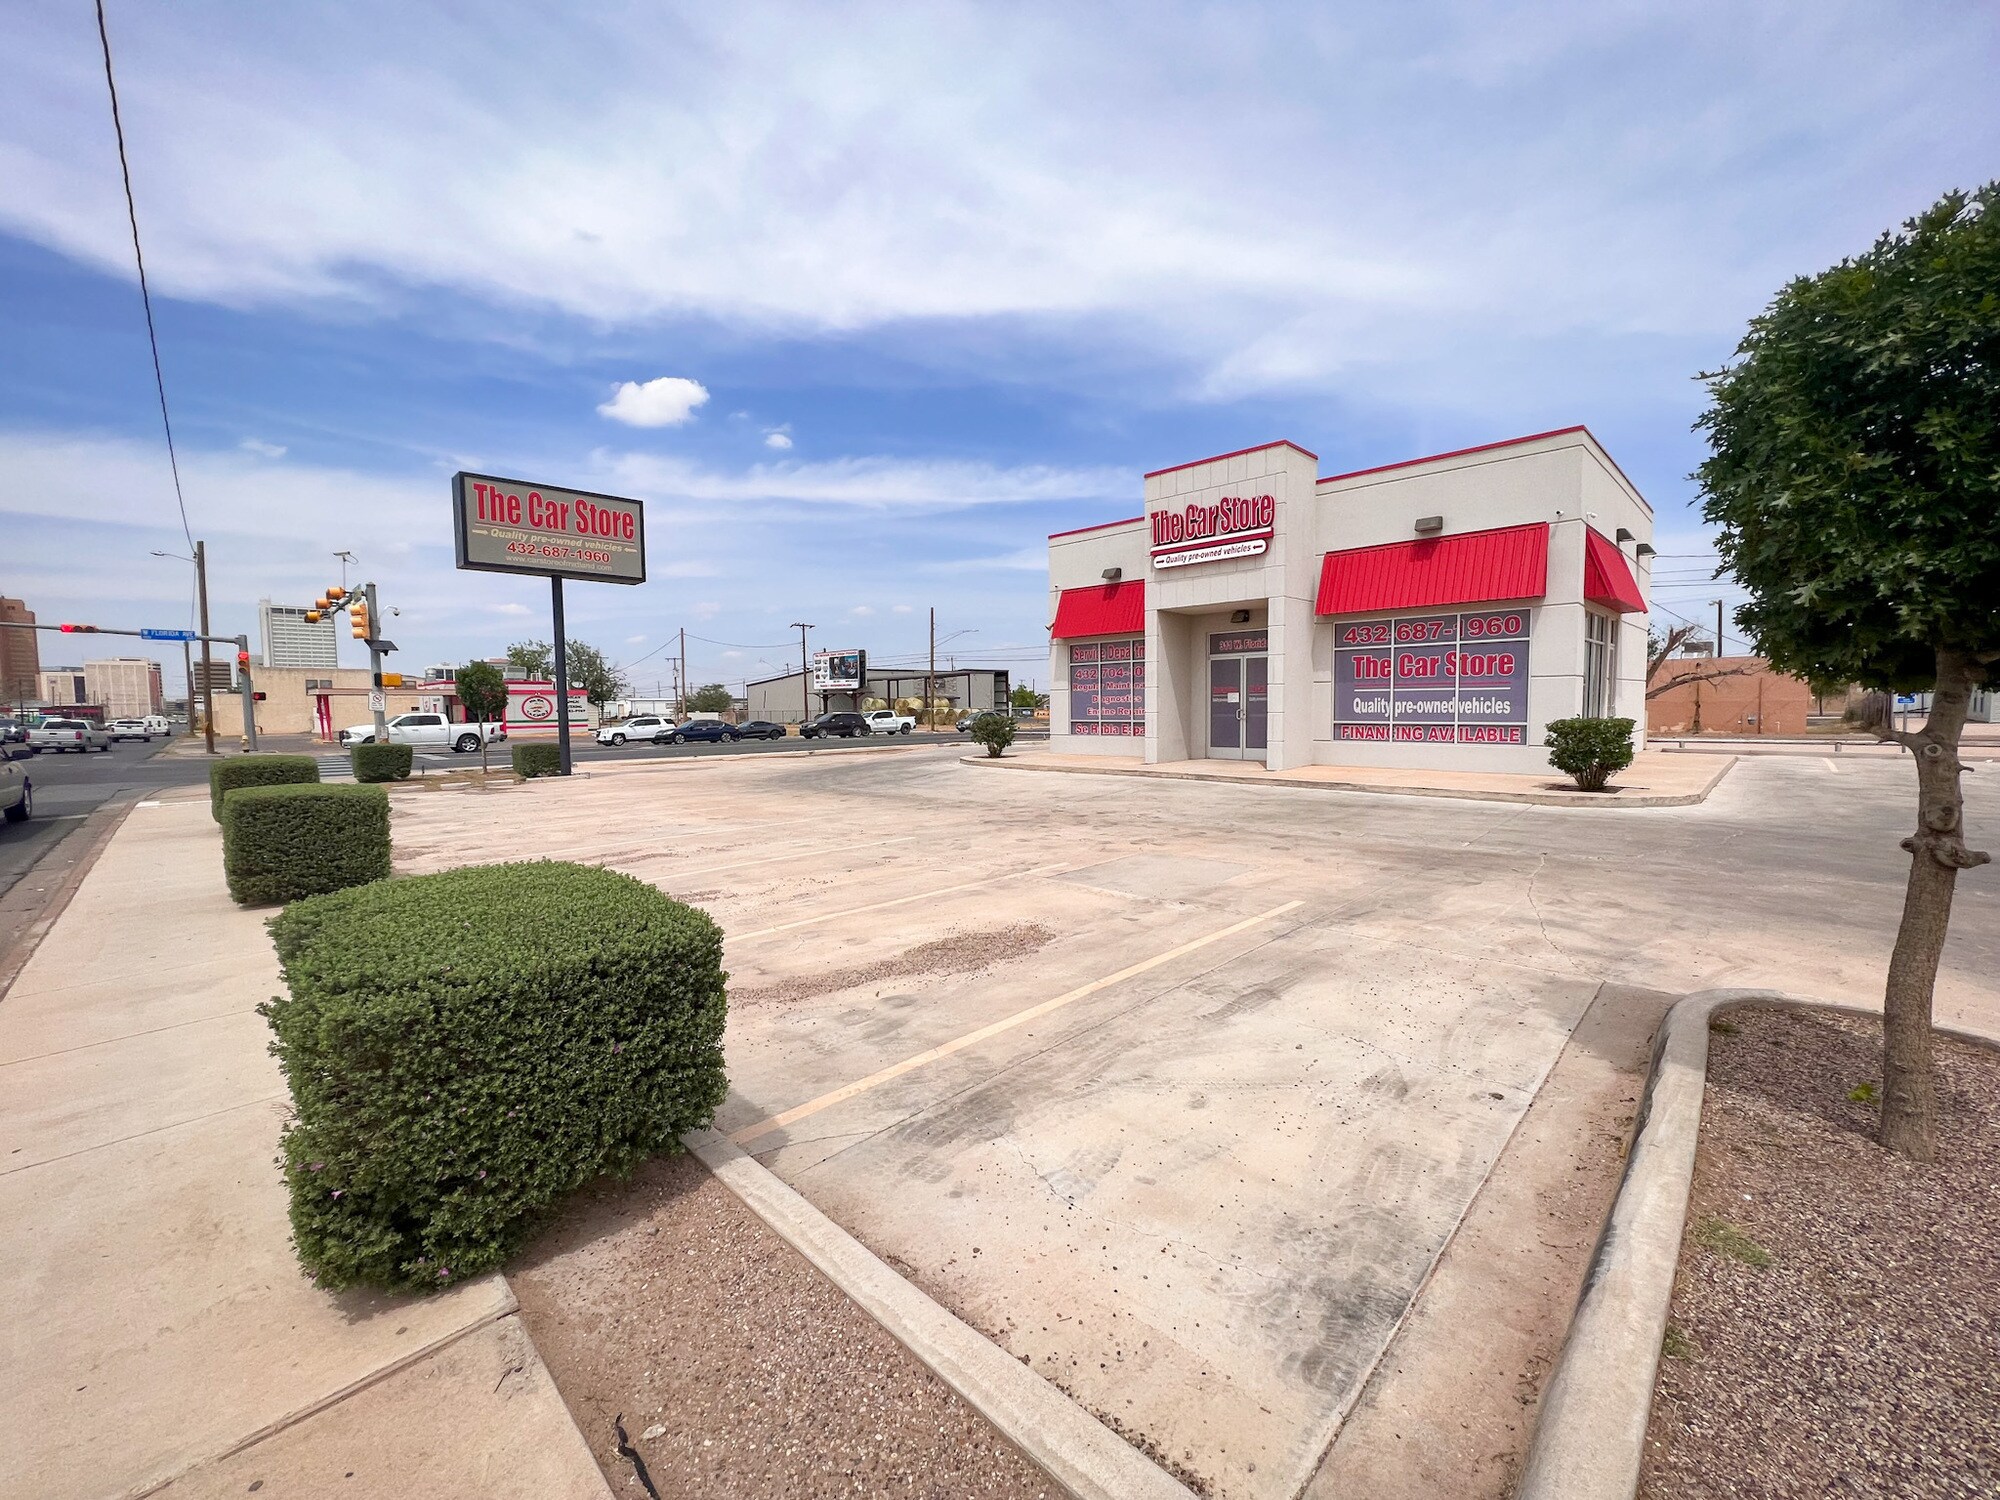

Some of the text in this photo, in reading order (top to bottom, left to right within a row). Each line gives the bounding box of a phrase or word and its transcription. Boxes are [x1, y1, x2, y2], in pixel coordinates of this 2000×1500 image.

[473, 482, 634, 541] The Car Store
[1150, 495, 1275, 545] The Car Store
[491, 528, 623, 553] Quality pre-owned vehicles
[507, 541, 611, 563] 432-687-1960
[1166, 544, 1252, 565] Quality pre-owned vehicles
[1343, 615, 1522, 644] 432-687-1960
[1073, 645, 1106, 661] Servie
[1244, 638, 1266, 650] Florid
[1352, 651, 1515, 680] The Car Store
[1353, 697, 1511, 717] Quality pre-owned vehicles
[1076, 723, 1088, 734] Se
[1090, 723, 1119, 734] Hbla
[1427, 726, 1522, 743] AVAILABLE
